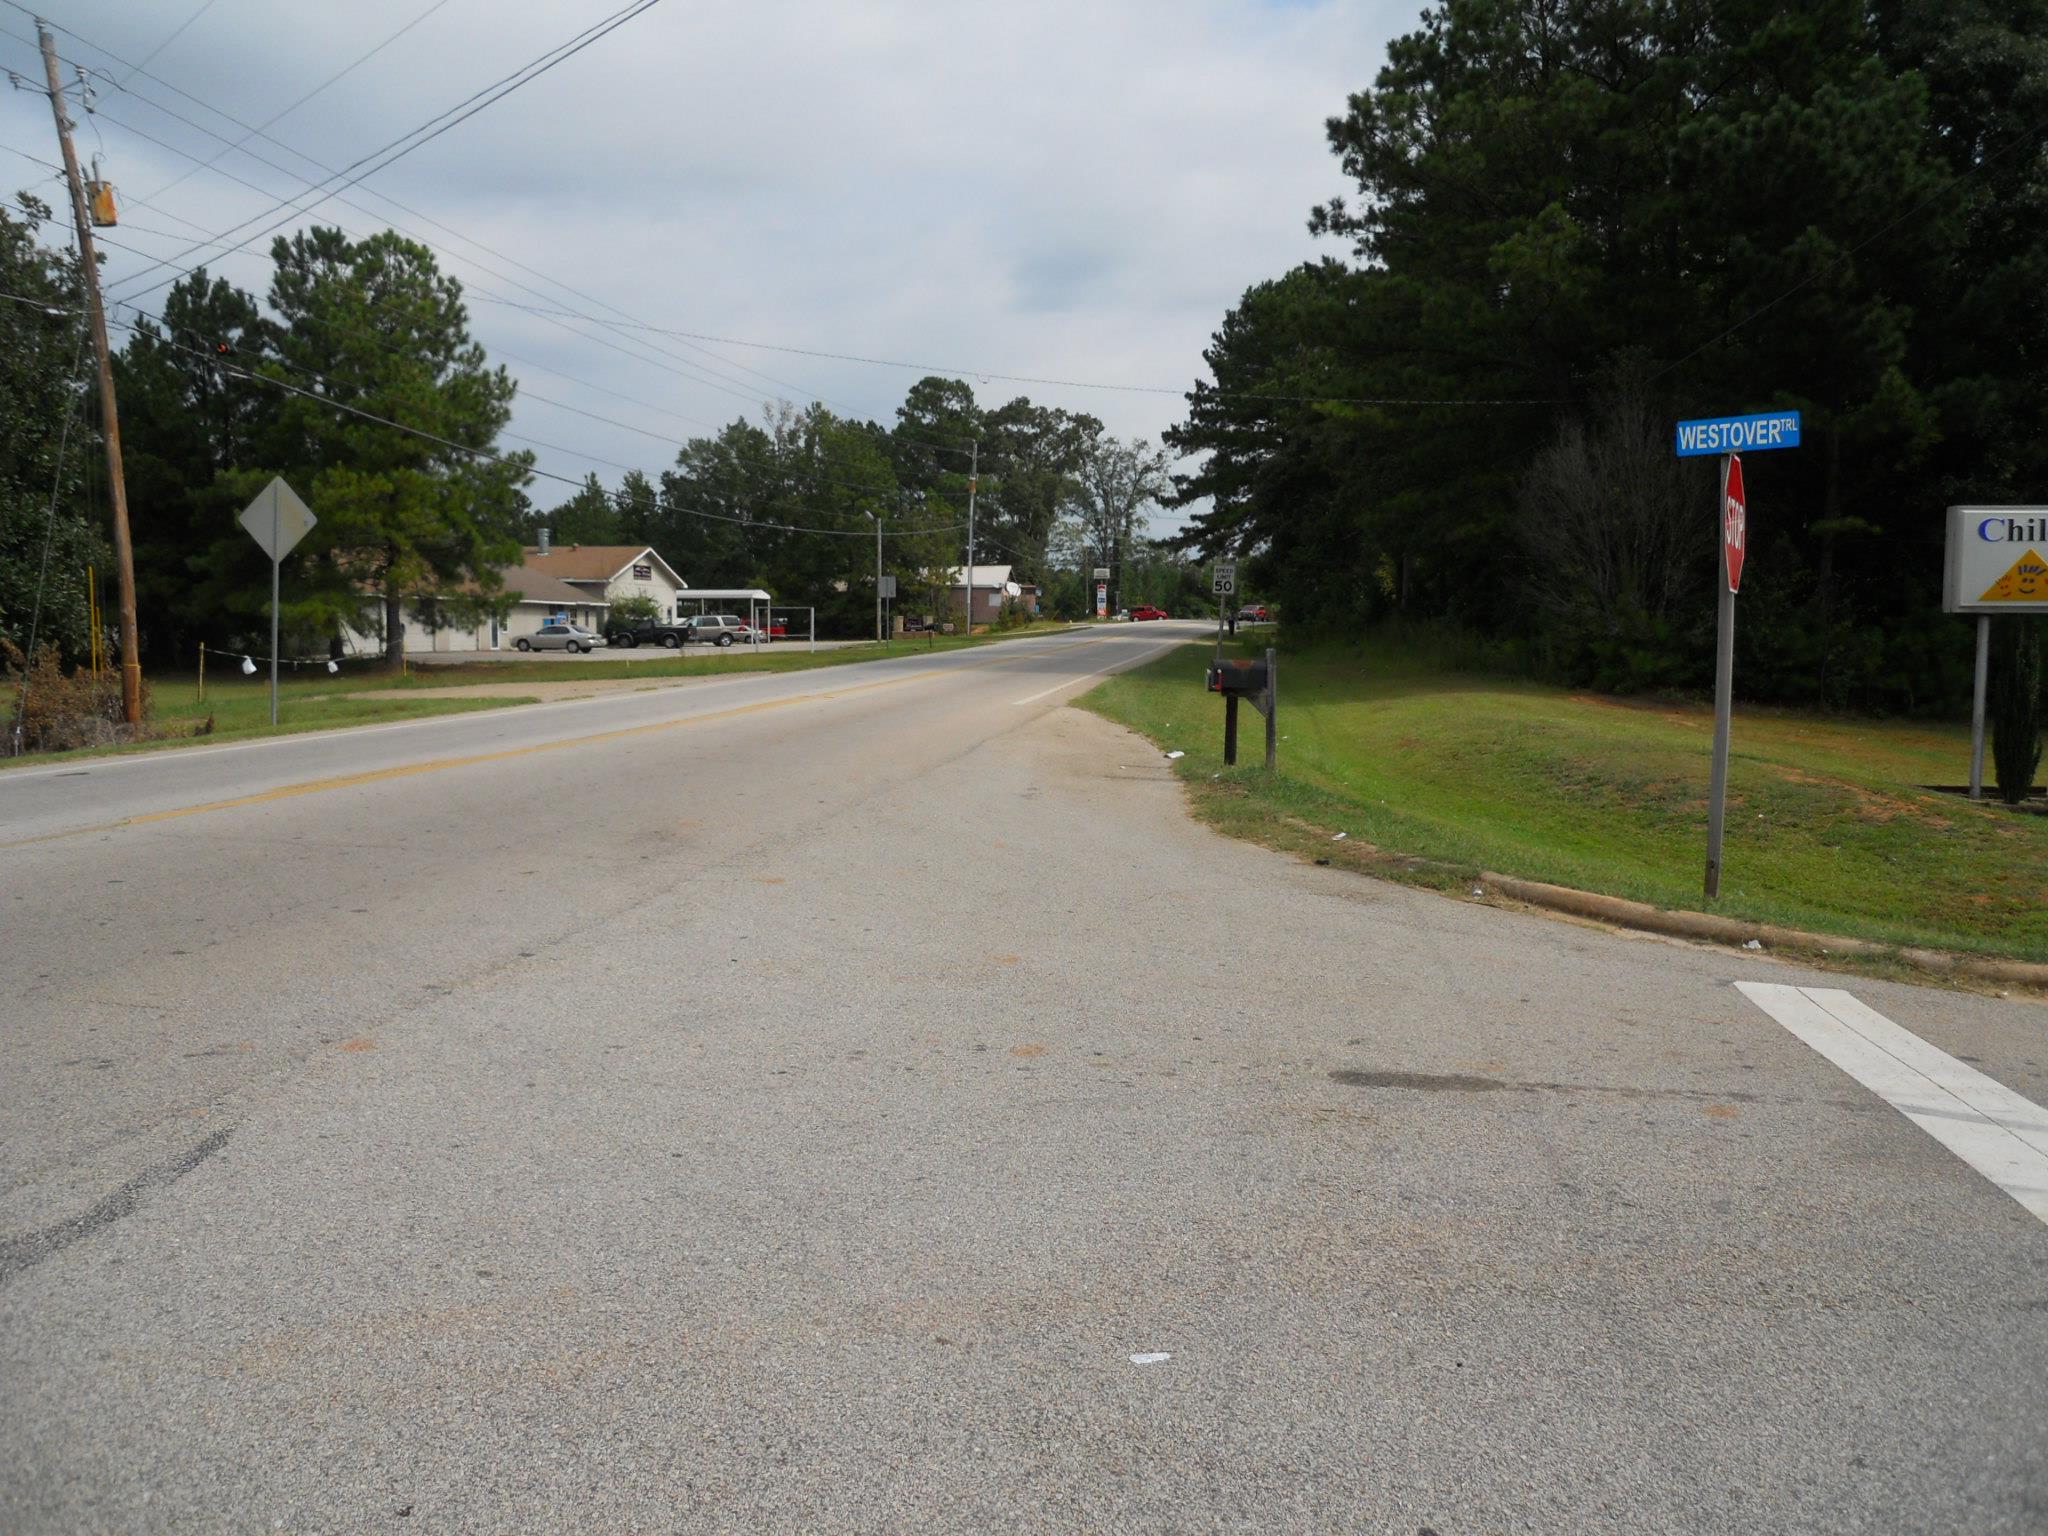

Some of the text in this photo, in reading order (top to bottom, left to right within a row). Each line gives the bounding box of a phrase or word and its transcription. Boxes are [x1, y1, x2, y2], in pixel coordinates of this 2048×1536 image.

[1679, 418, 1798, 449] WESTOVER TRL
[1726, 496, 1744, 550] STOP
[1214, 580, 1233, 592] 50
